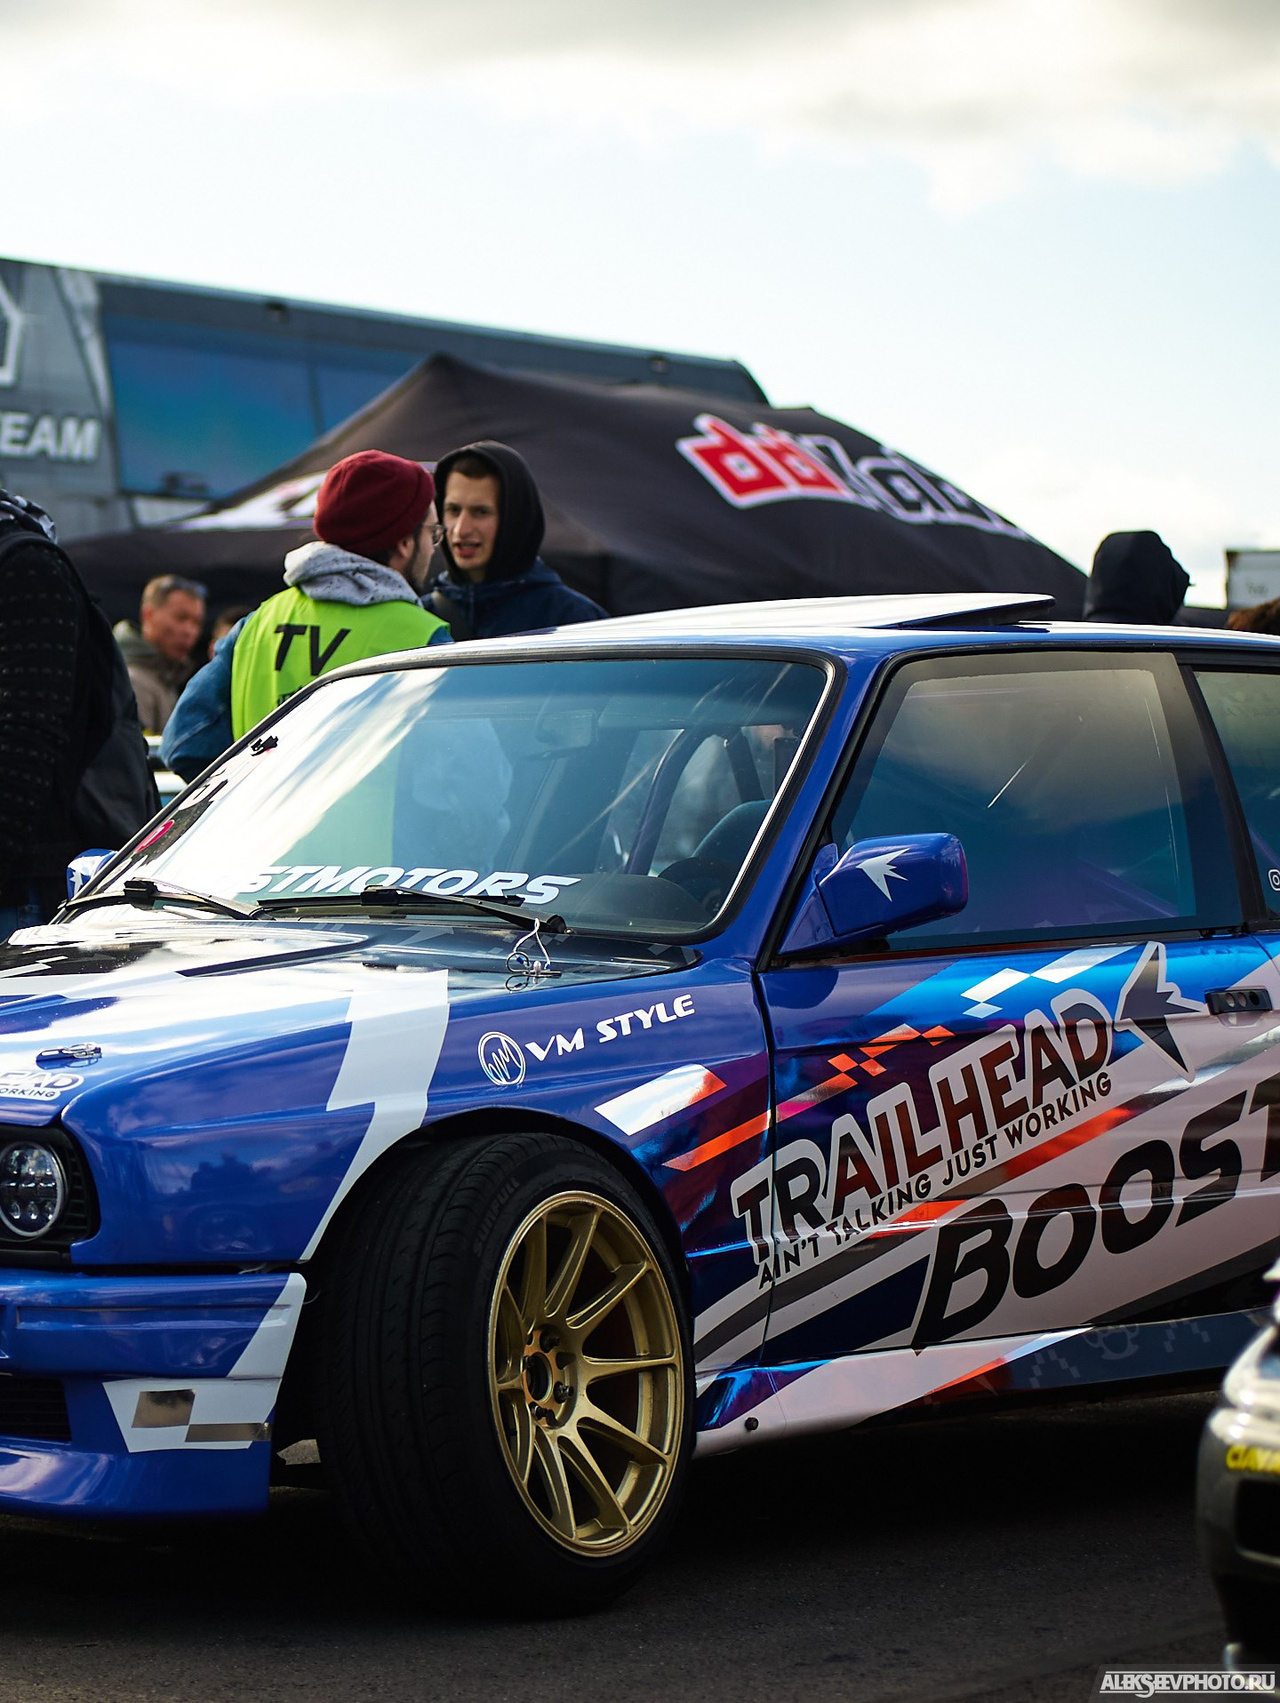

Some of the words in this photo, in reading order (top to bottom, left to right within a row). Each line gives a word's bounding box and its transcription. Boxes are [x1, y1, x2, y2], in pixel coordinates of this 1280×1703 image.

[274, 623, 351, 676] TV
[525, 1027, 585, 1062] VM
[596, 994, 696, 1044] STYLE
[736, 1002, 1109, 1265] TRAILHEAD
[758, 1235, 821, 1290] AIN'T
[825, 1174, 932, 1247] TALKING
[942, 1137, 999, 1187] JUST
[1004, 1071, 1112, 1149] WORKING
